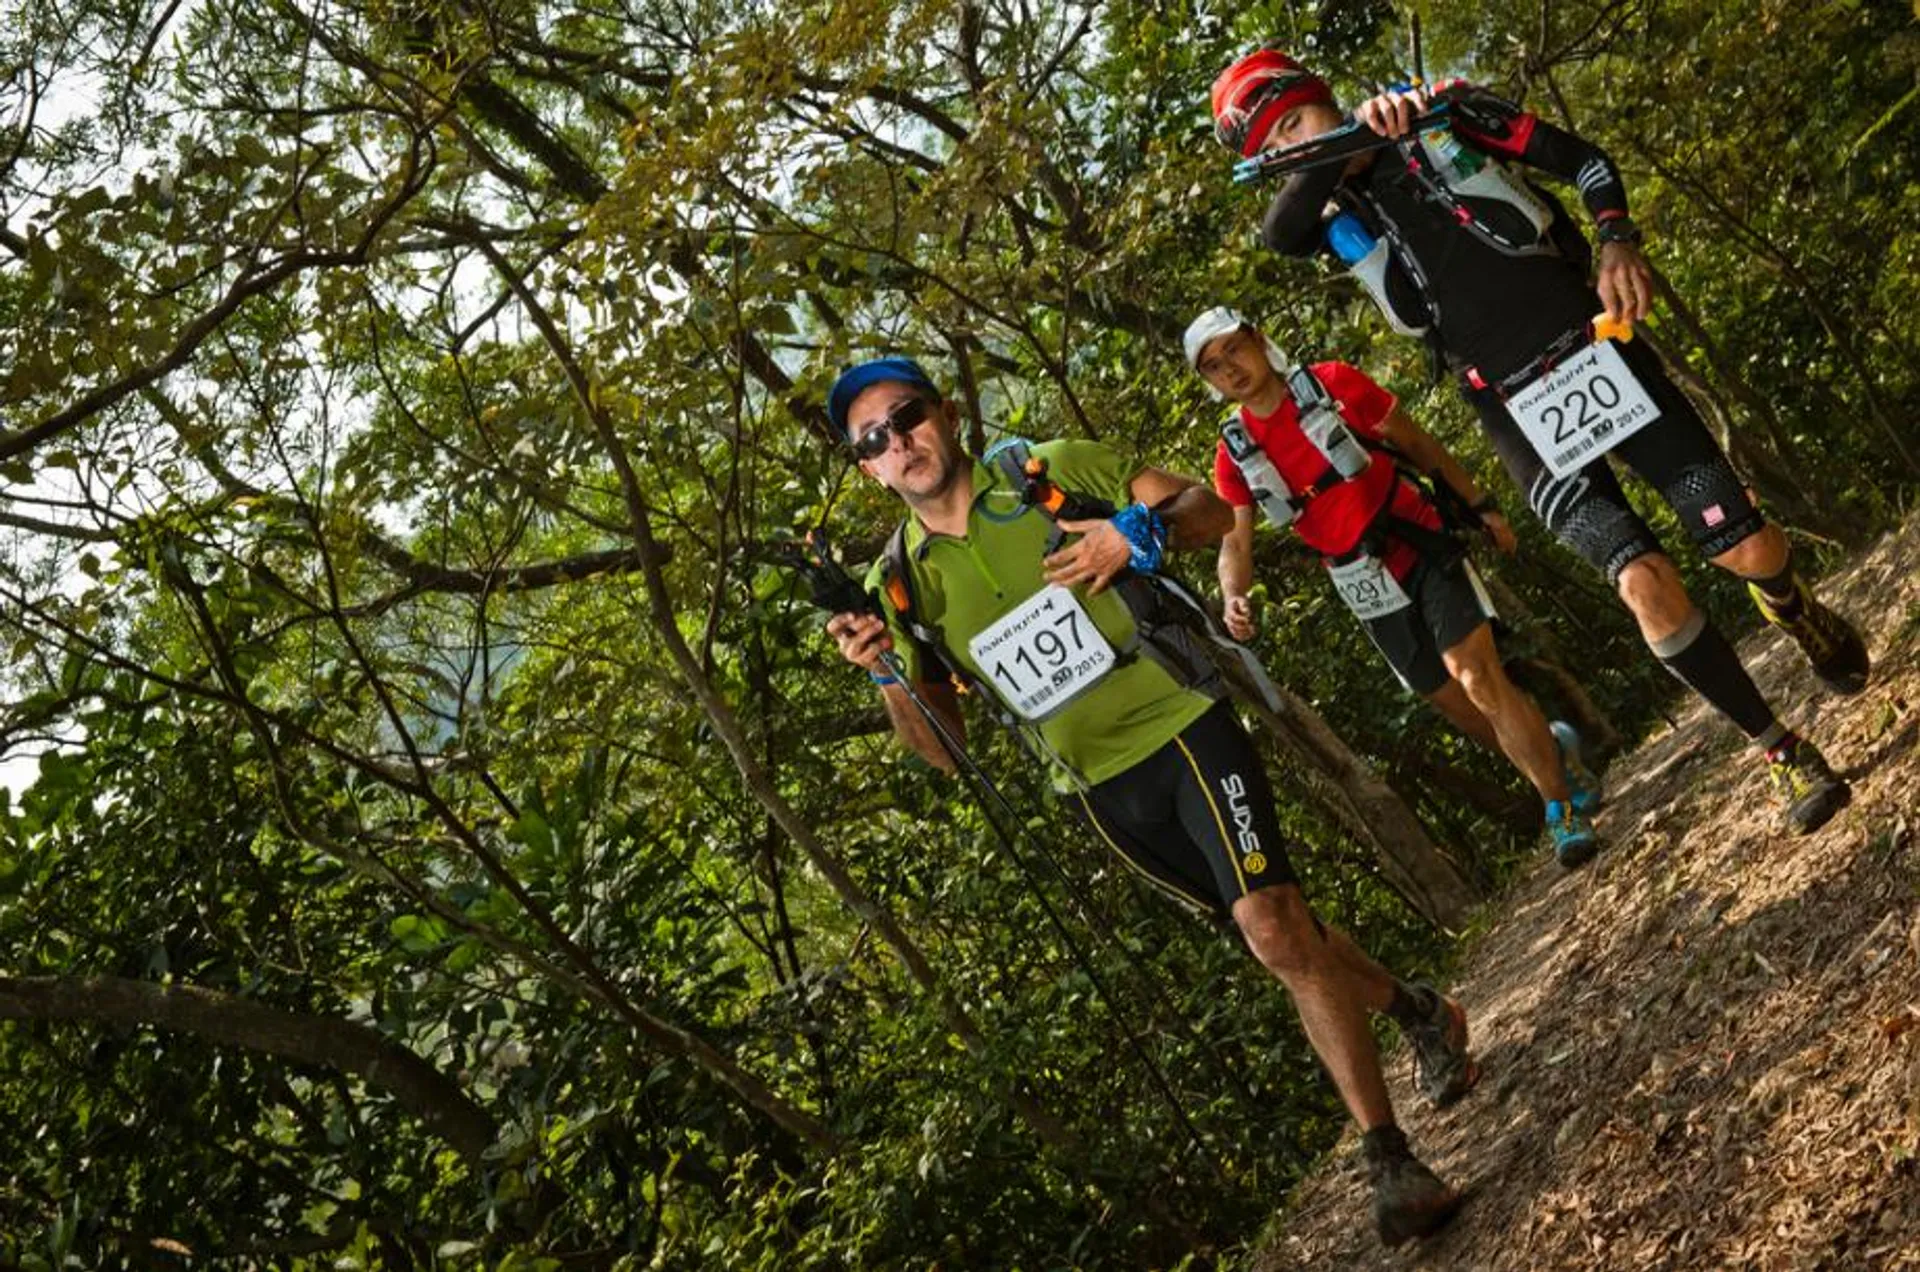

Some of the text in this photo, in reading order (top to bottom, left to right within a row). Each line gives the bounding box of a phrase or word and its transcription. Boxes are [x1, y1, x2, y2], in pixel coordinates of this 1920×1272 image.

[1541, 375, 1620, 444] 220
[1616, 404, 1646, 427] 2013
[995, 610, 1084, 692] 1197
[1075, 651, 1105, 677] 2013
[1220, 773, 1261, 854] SKINS
